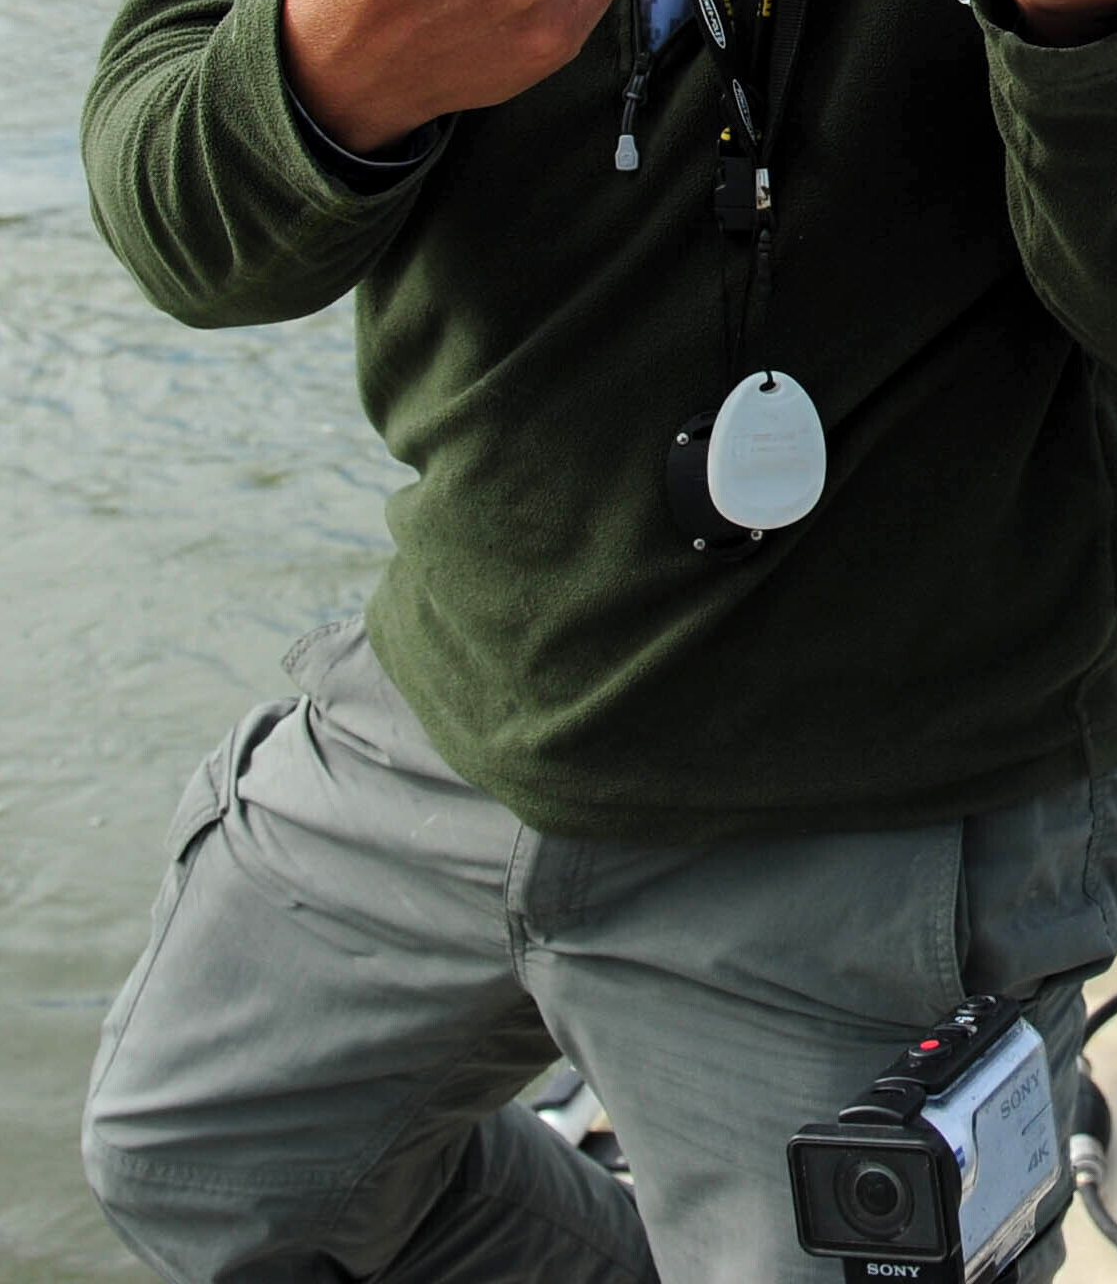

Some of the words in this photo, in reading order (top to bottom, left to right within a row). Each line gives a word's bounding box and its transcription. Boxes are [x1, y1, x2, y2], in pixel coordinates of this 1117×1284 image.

[1001, 1068, 1040, 1121] SONY
[1027, 1139, 1050, 1173] 4K
[866, 1263, 920, 1278] SONY
